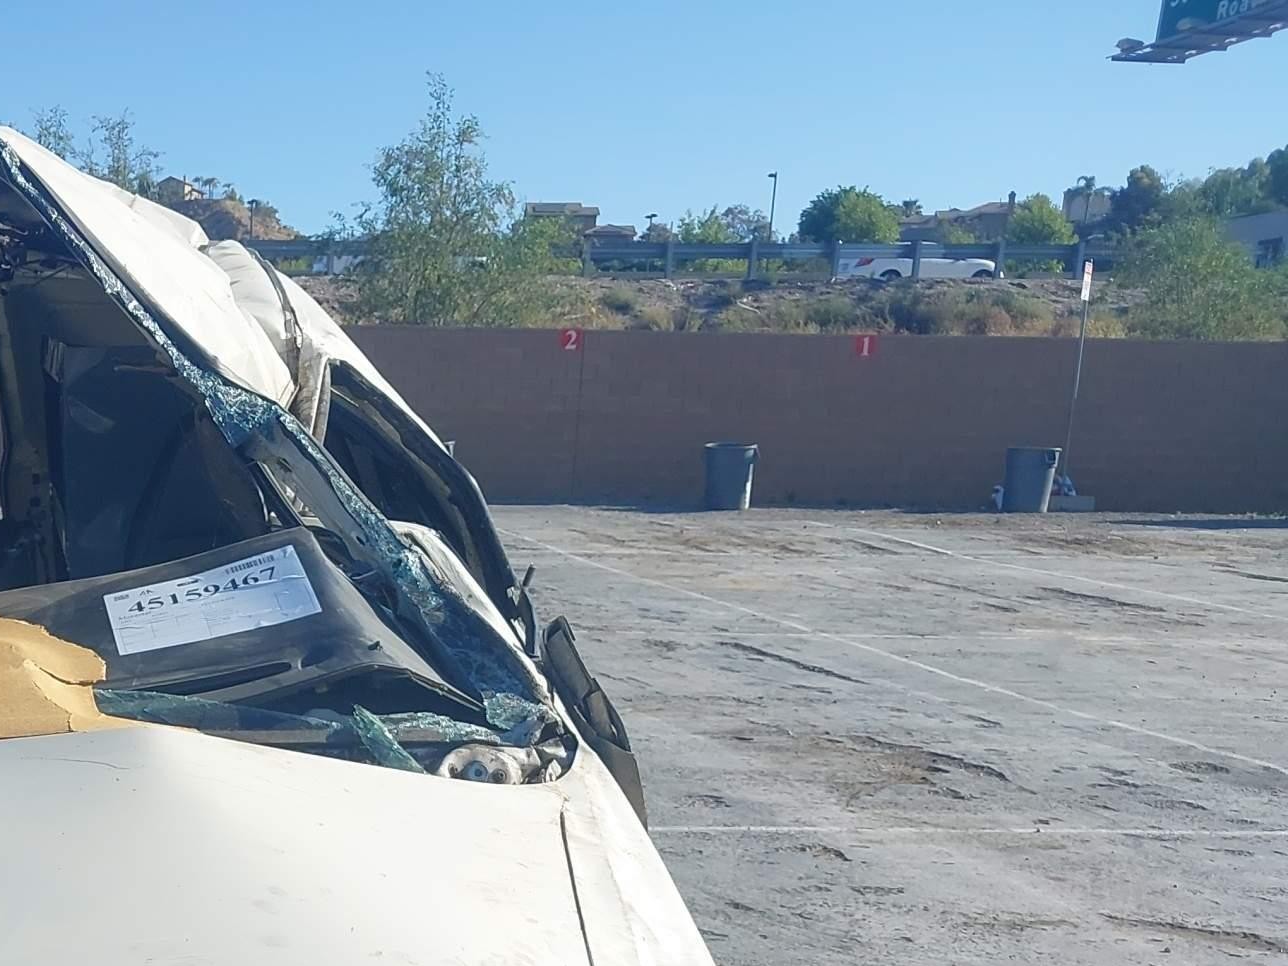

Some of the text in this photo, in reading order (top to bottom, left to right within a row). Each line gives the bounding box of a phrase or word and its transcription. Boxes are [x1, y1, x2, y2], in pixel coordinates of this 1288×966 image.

[565, 330, 577, 350] 2
[860, 336, 870, 356] 1
[127, 566, 276, 613] 45159467
